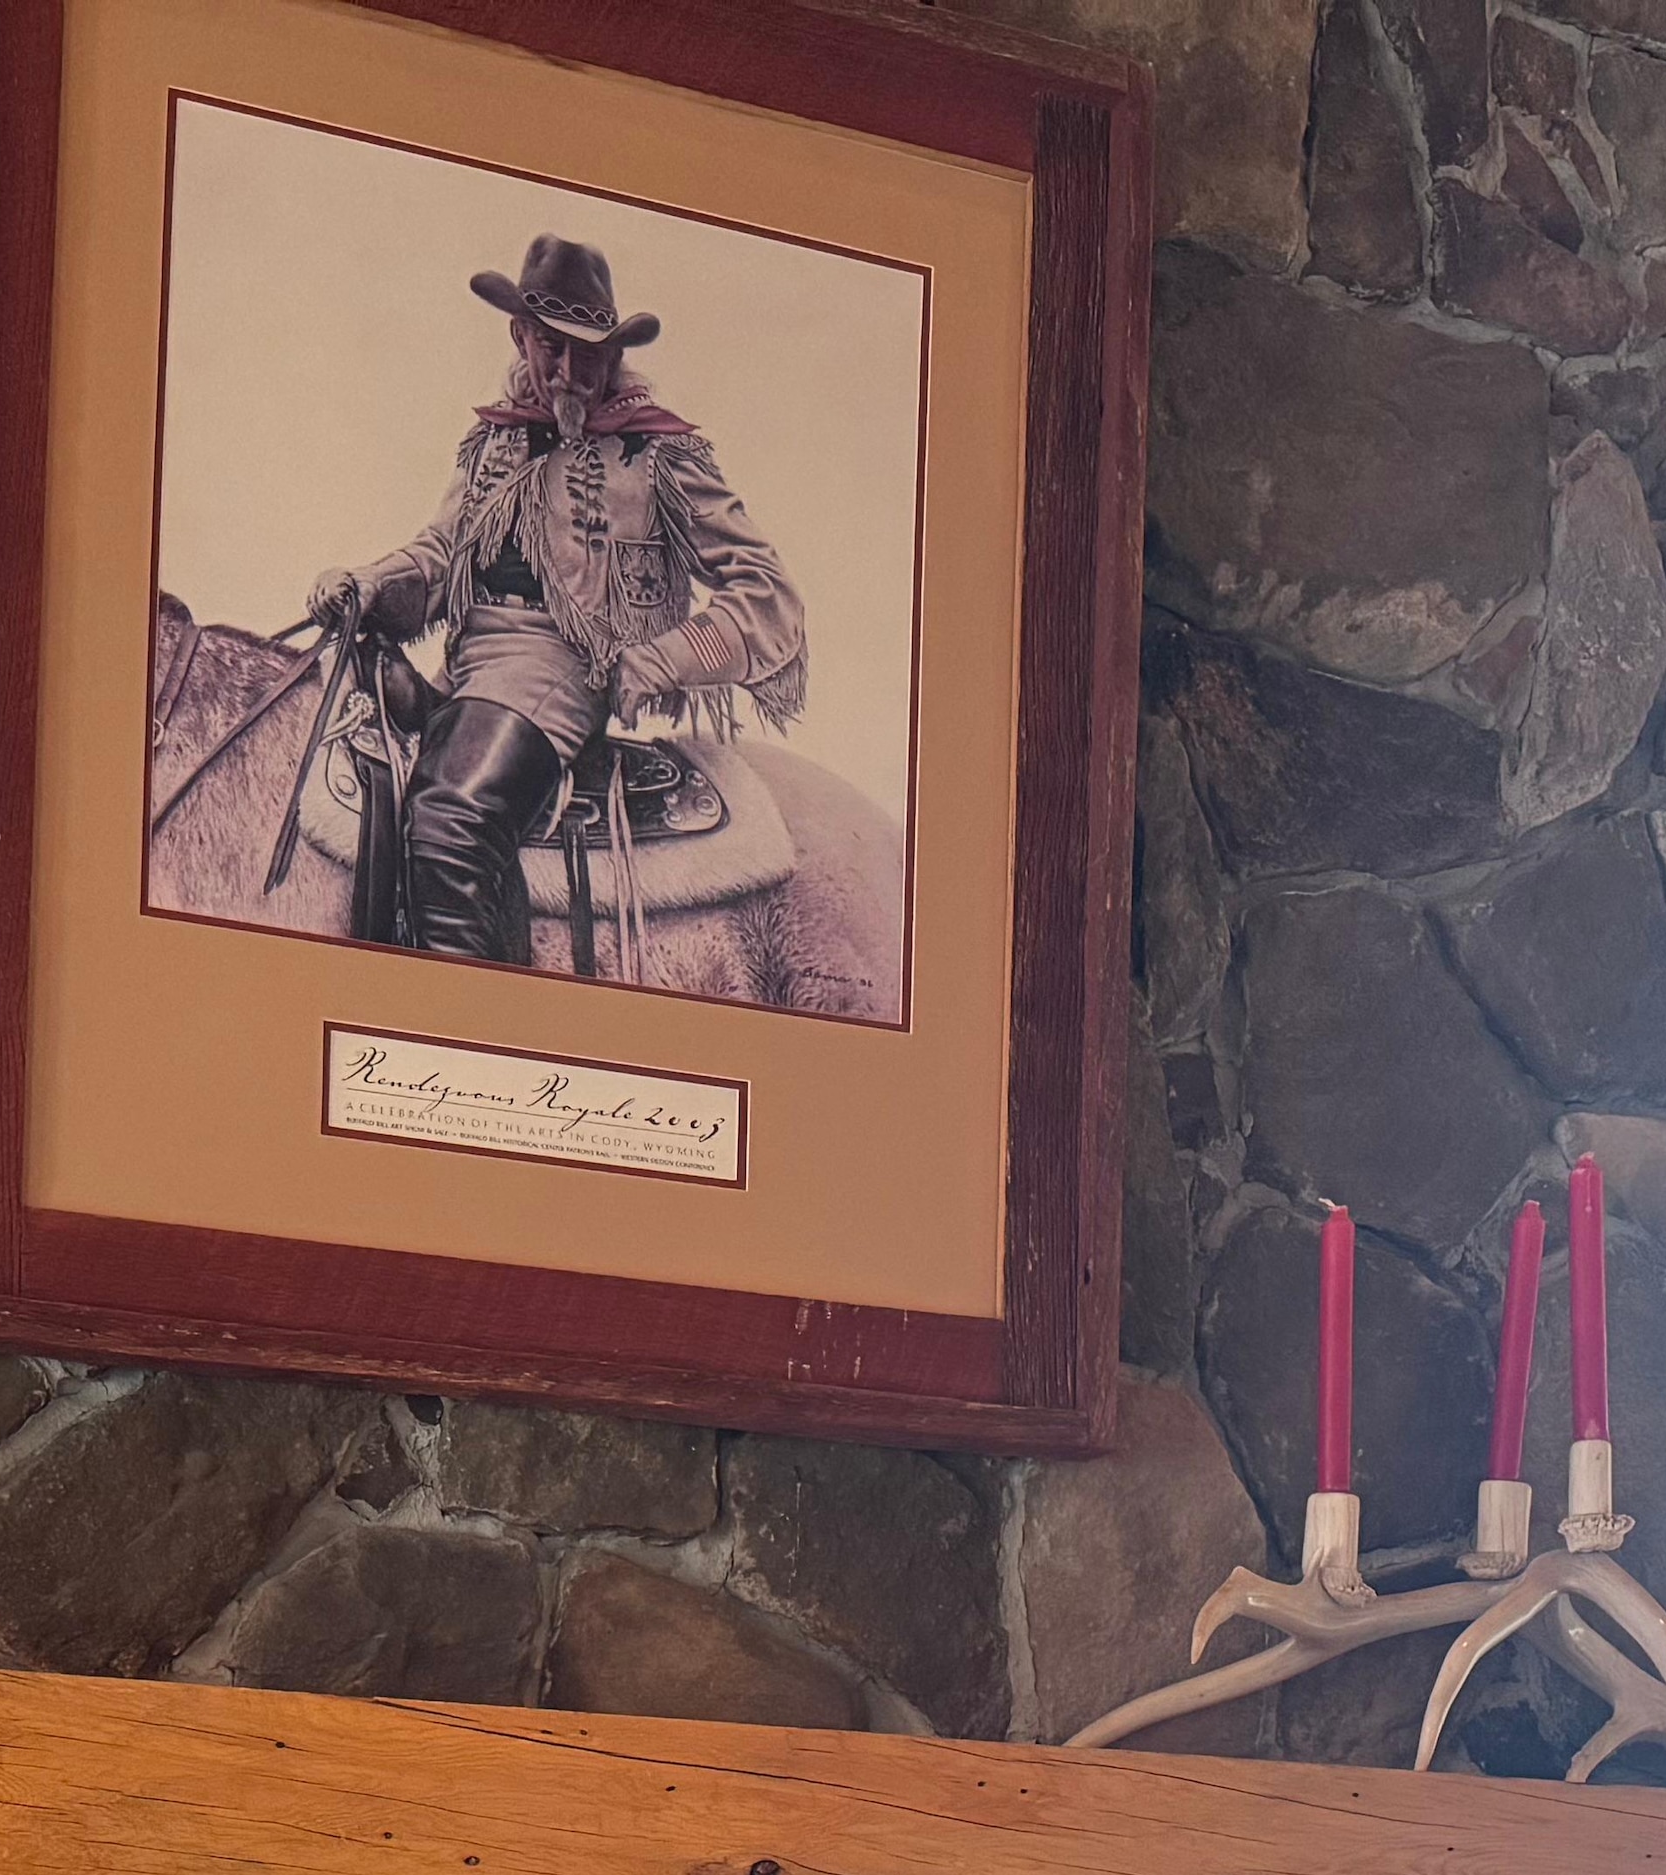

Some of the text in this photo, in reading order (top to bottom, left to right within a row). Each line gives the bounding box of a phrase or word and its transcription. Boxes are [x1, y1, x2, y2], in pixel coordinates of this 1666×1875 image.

[342, 1047, 726, 1143] Rendezvous Royale 2003
[346, 1102, 716, 1159] A CELEBRATION OF THE ARTS IN CODY, WYOMING
